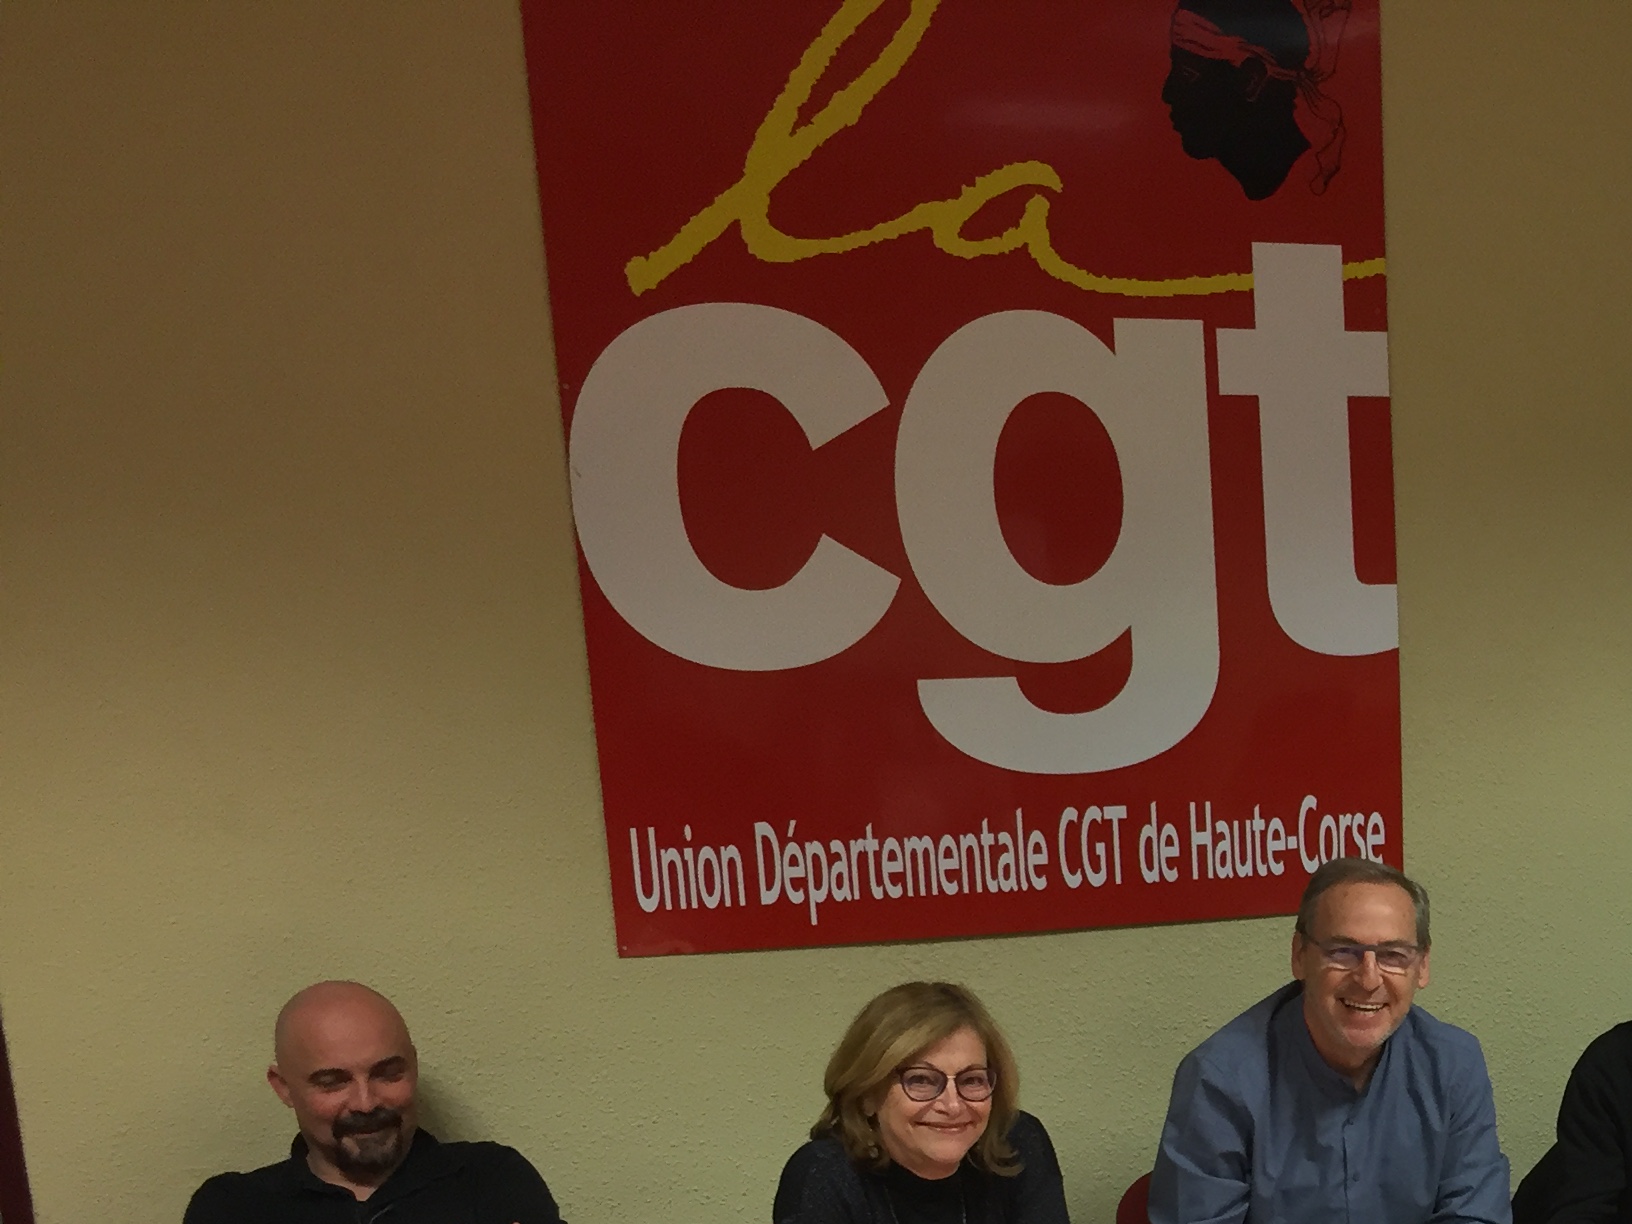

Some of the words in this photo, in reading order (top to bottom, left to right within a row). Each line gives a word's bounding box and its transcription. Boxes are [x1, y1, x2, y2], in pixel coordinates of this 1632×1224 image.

[570, 242, 1399, 775] cgt
[630, 824, 746, 912] Union
[754, 807, 1048, 926] Départementale
[1058, 805, 1127, 889] CGT
[1139, 801, 1180, 883] de
[1190, 794, 1385, 880] Haute-Corse
